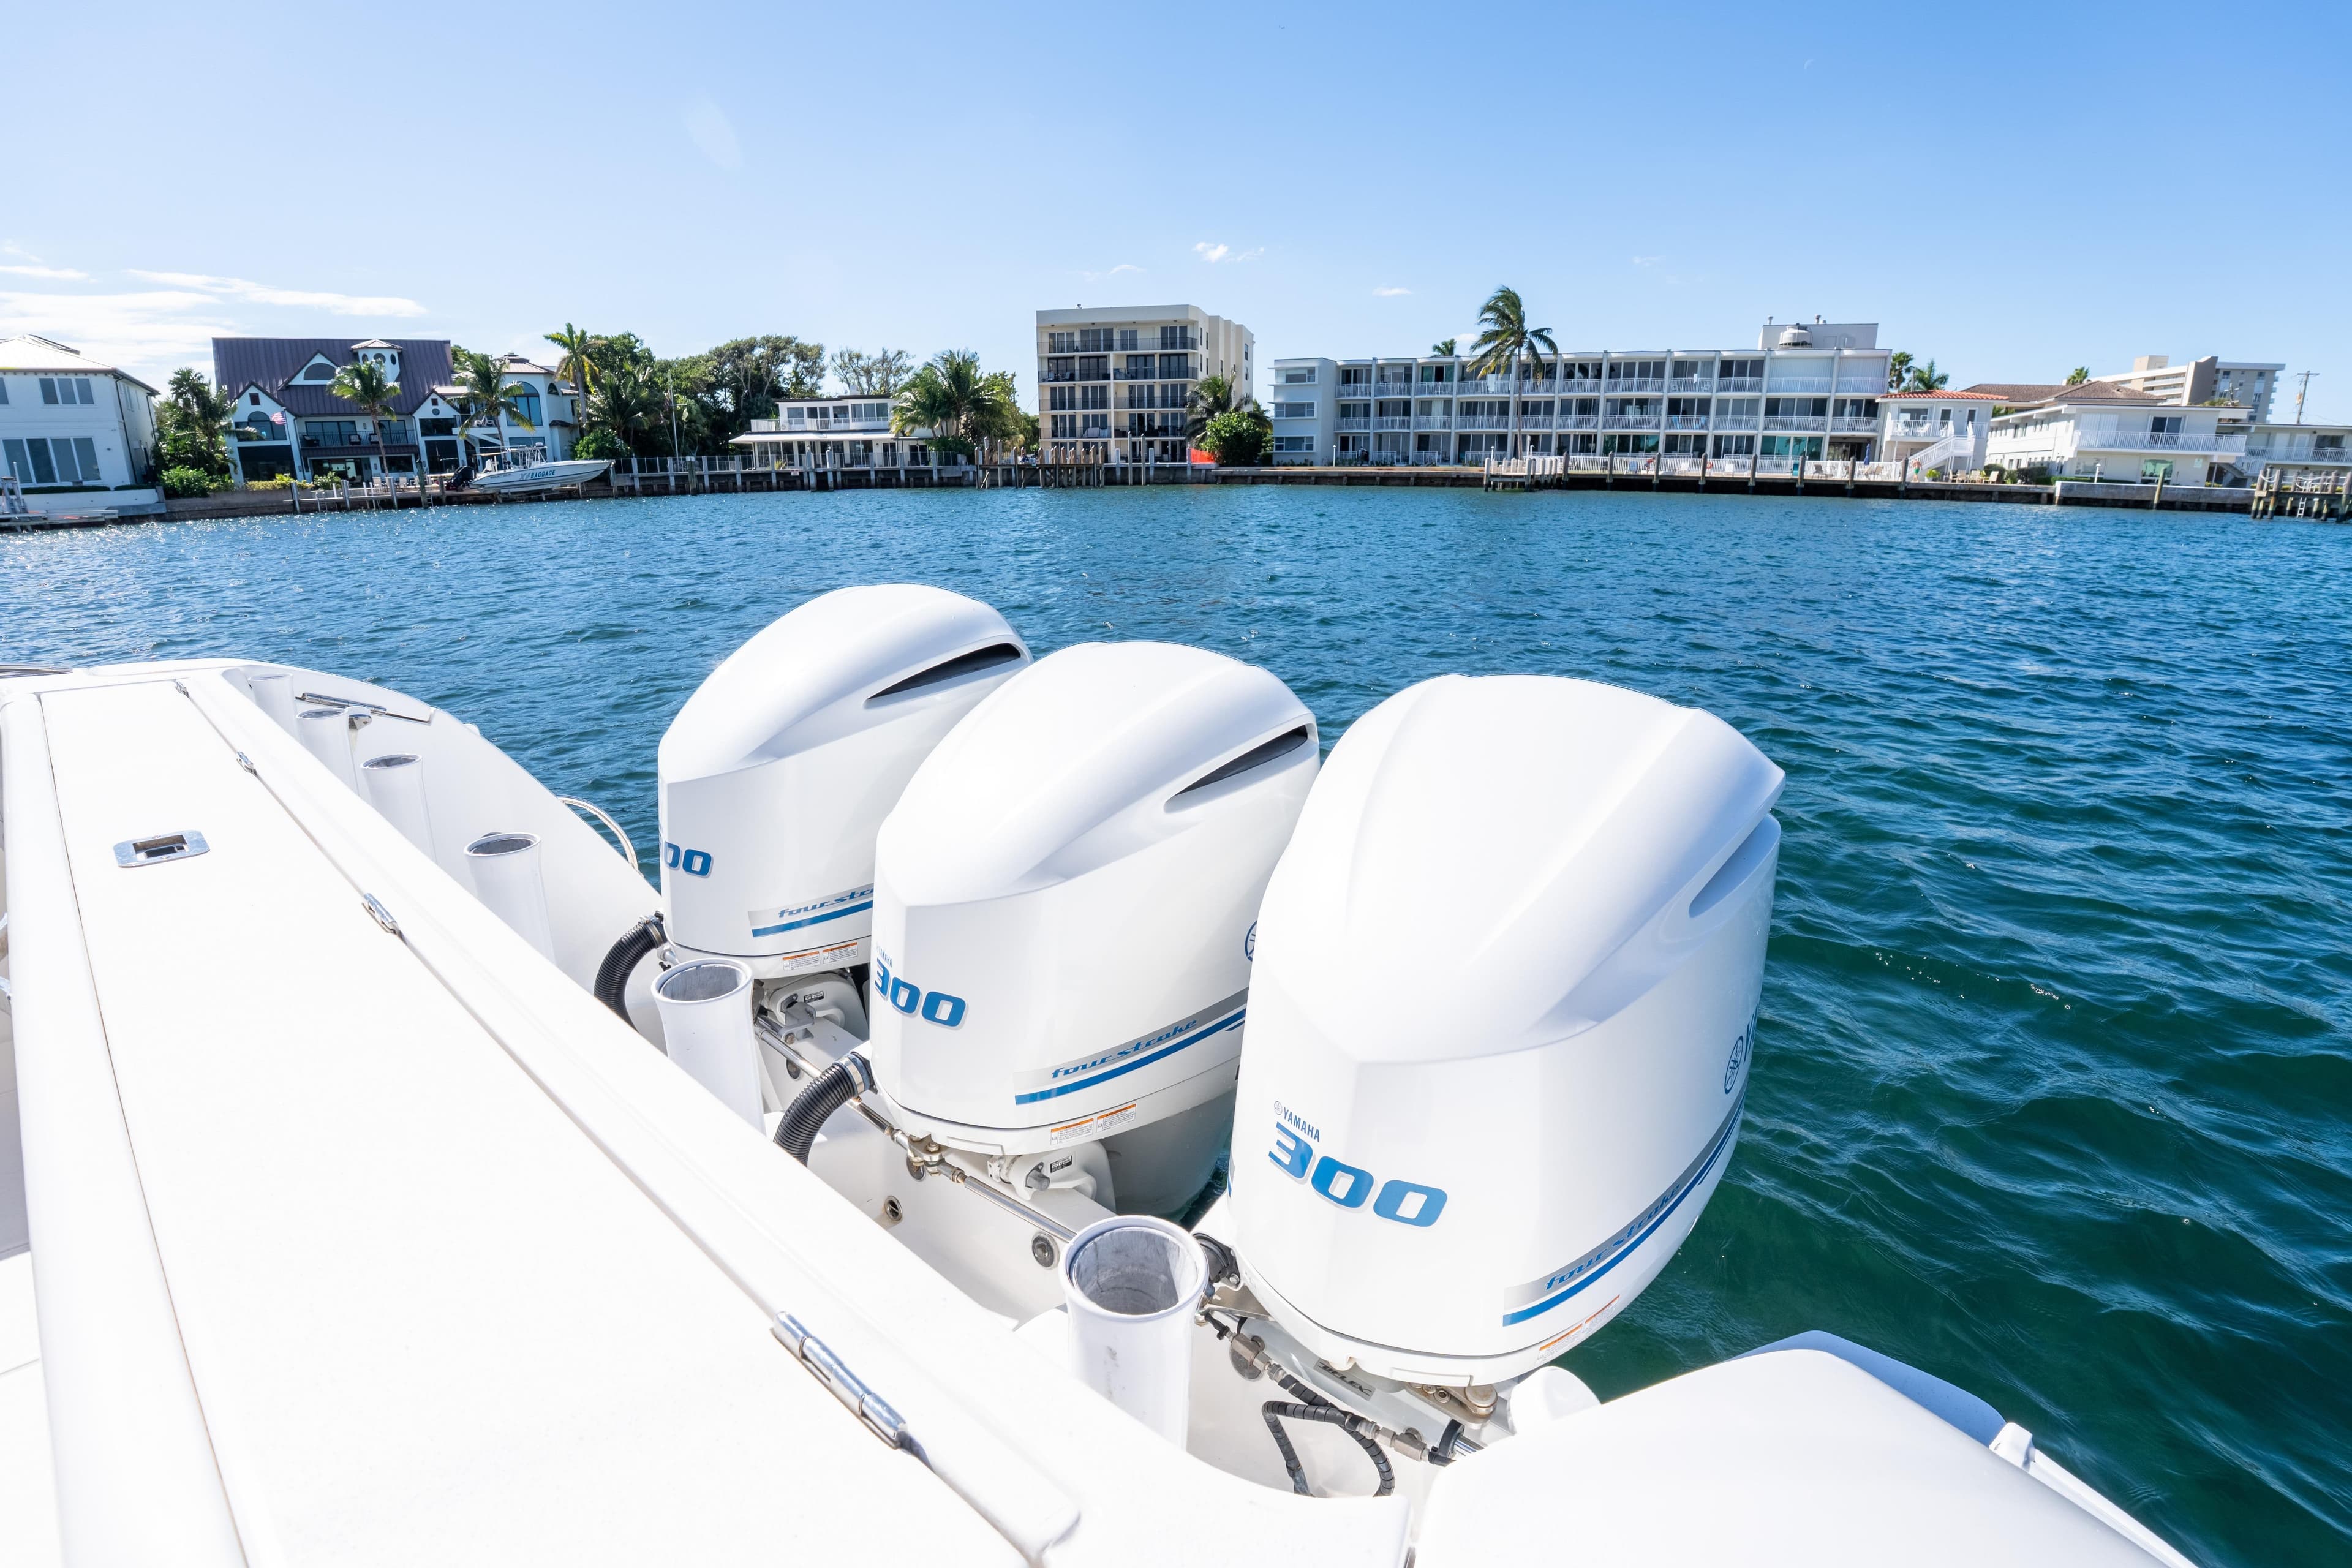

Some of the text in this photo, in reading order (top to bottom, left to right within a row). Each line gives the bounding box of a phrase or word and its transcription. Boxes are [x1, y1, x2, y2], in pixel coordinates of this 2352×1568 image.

[530, 469, 556, 478] BAGGAGE
[665, 841, 712, 876] 00
[875, 957, 967, 1027] 300
[1283, 1107, 1321, 1142] YAMAHA
[1268, 1121, 1448, 1227] 300
